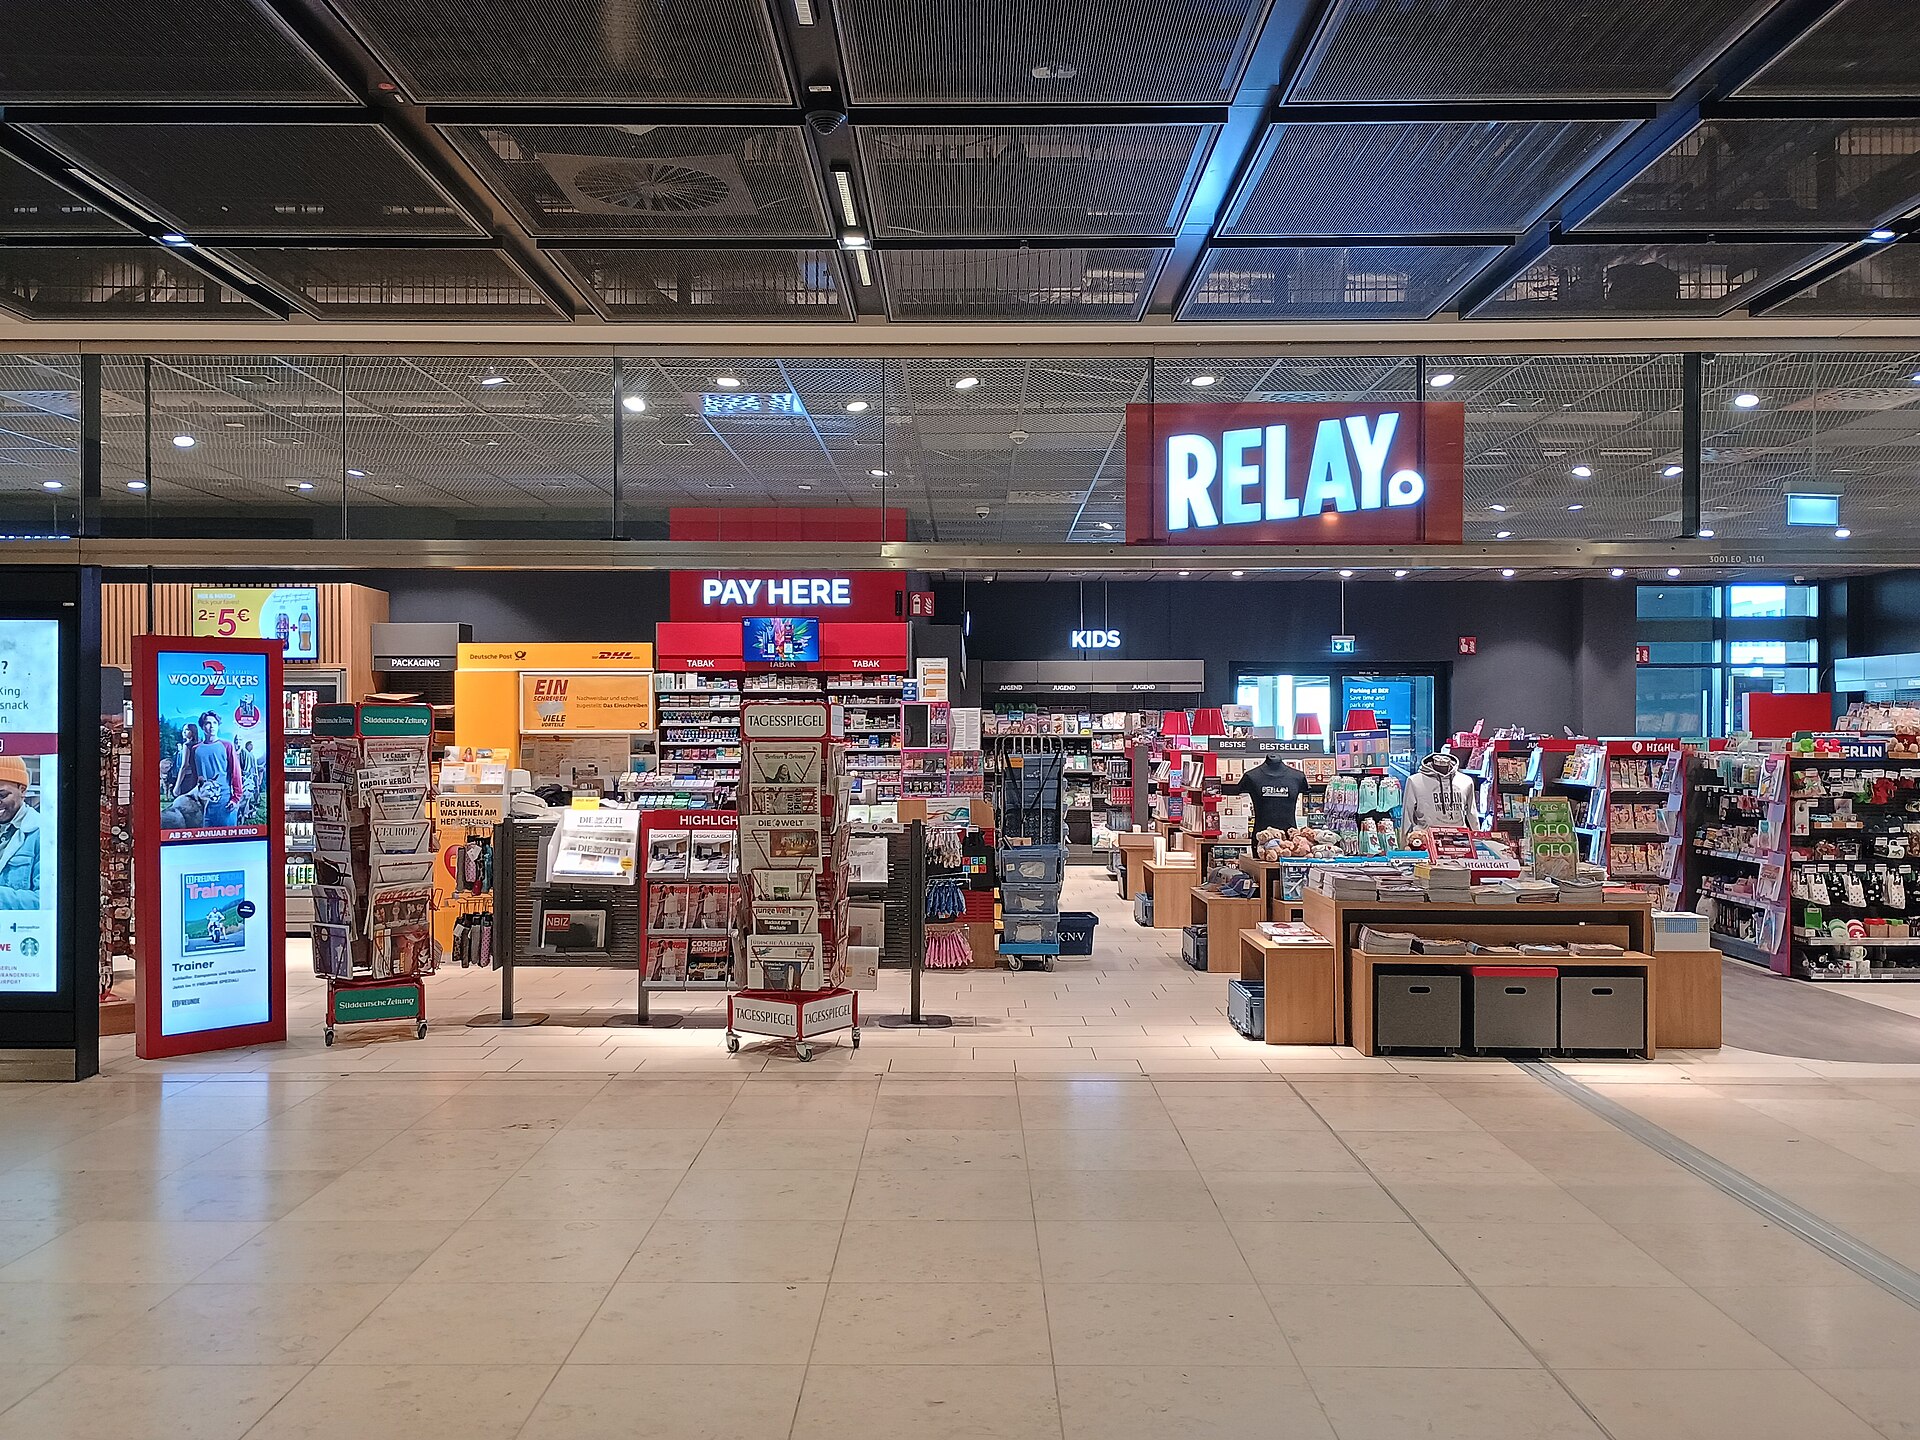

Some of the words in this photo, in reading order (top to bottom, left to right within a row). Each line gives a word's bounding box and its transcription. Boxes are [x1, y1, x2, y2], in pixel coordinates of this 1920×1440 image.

[703, 578, 761, 605] PAY
[767, 578, 851, 605] HERE
[1071, 630, 1121, 648] KIDS
[597, 651, 634, 660] DHL
[391, 658, 440, 667] PACKAGING
[686, 660, 715, 668] TABAK
[852, 660, 880, 668] TABAK
[168, 674, 259, 688] WOODWALKERS
[200, 660, 226, 696] 2
[534, 679, 569, 695] EIN
[1350, 687, 1371, 695] Parking
[363, 716, 404, 724] Süddeutsche
[405, 716, 428, 725] Zeitung
[542, 714, 567, 722] VIELE
[748, 715, 825, 727] TAGESSPIEGEL
[1259, 743, 1310, 751] BESTSELLER
[440, 799, 456, 808] FÜR
[456, 800, 482, 808] ALLES,
[1539, 803, 1559, 812] GEO
[579, 816, 593, 824] DIE
[604, 816, 623, 824] ZEIT
[758, 819, 772, 828] DIE
[182, 831, 194, 839] 29.
[195, 829, 227, 838] JANUAR
[1533, 823, 1570, 838] GEO
[577, 844, 593, 853] DIE
[603, 846, 622, 856] ZEIT
[1536, 843, 1574, 858] GEO
[186, 882, 243, 900] Trainer
[172, 961, 214, 972] Trainer
[339, 1000, 387, 1010] Süddeutsche
[386, 997, 415, 1007] Zeitung
[735, 1007, 796, 1026] TAGESSPIEGEL
[803, 1004, 852, 1025] TAGESSPIEGEL
